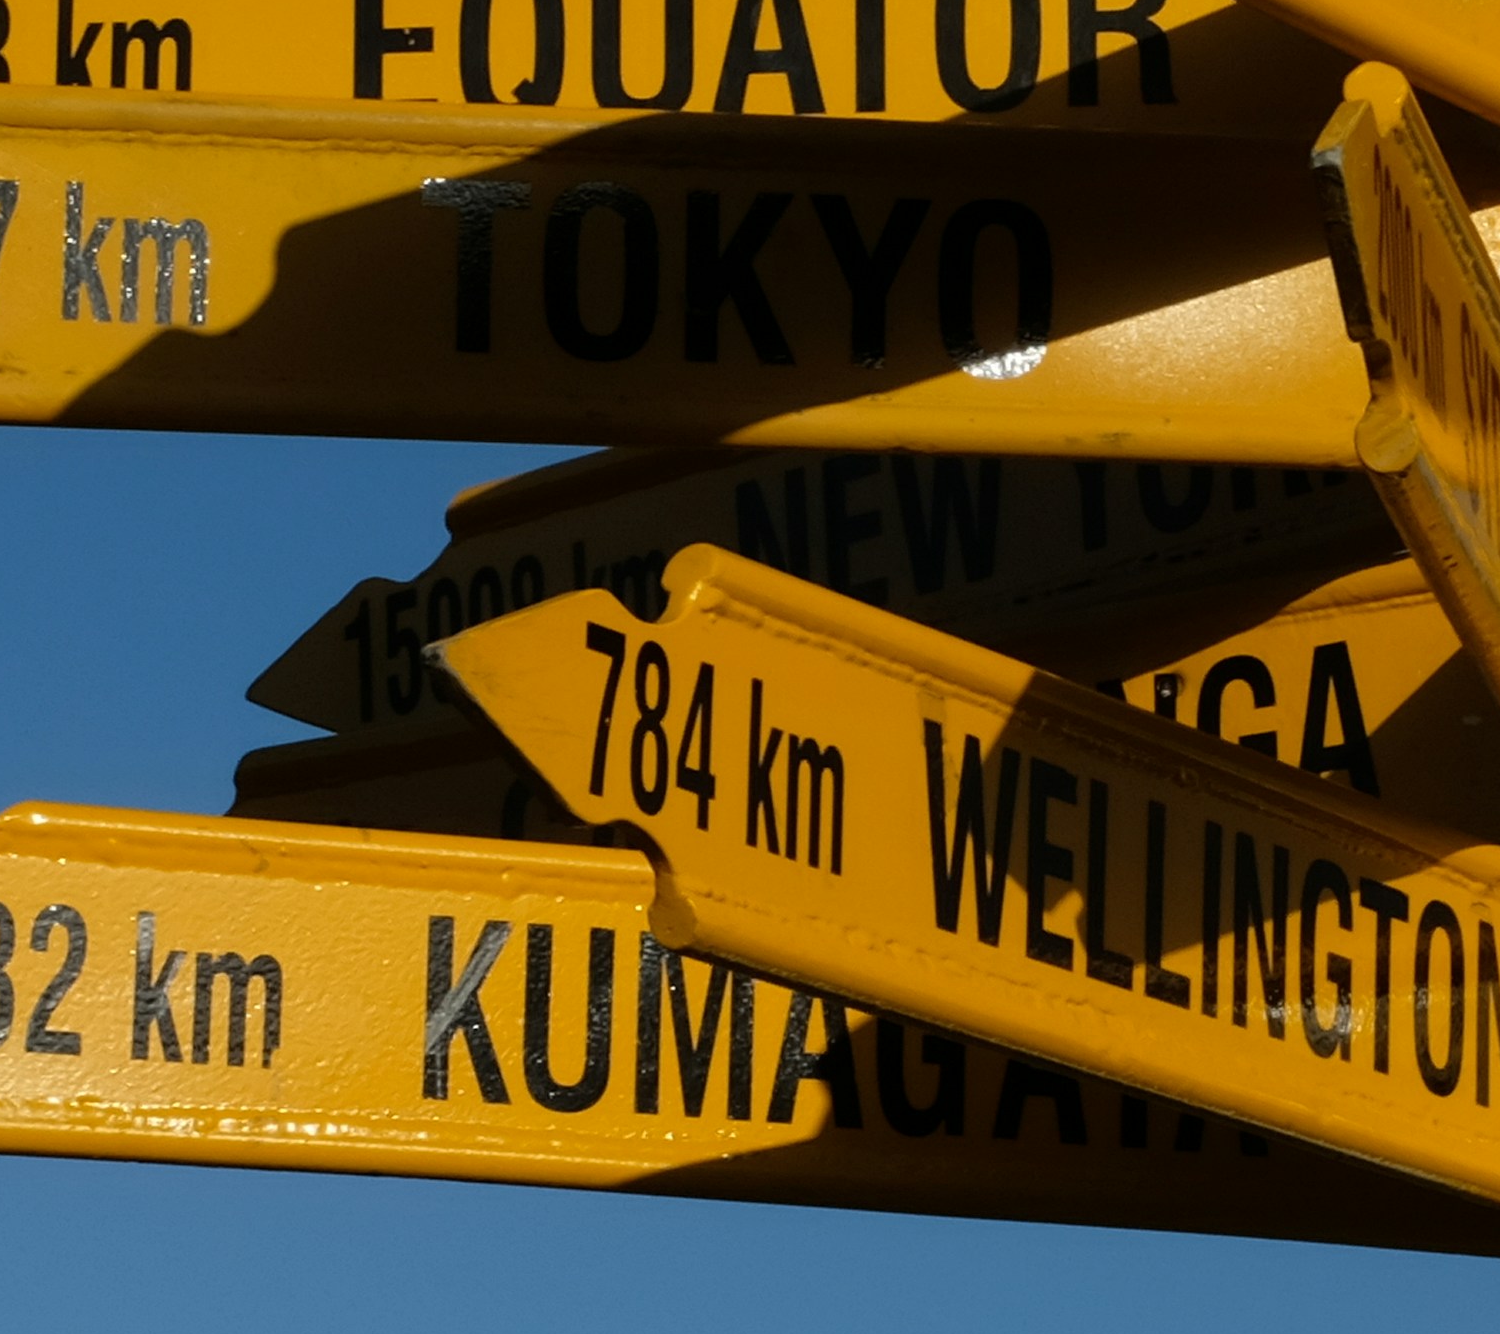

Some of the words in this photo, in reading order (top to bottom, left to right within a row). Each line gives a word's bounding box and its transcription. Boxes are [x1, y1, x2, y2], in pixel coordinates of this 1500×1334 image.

[61, 179, 211, 325] km
[415, 174, 1058, 382] TOKYO
[734, 452, 1002, 605] NEW
[586, 622, 716, 831] 784
[745, 677, 847, 879] km
[130, 910, 285, 1069] km
[422, 915, 1270, 1158] KUMAGA
